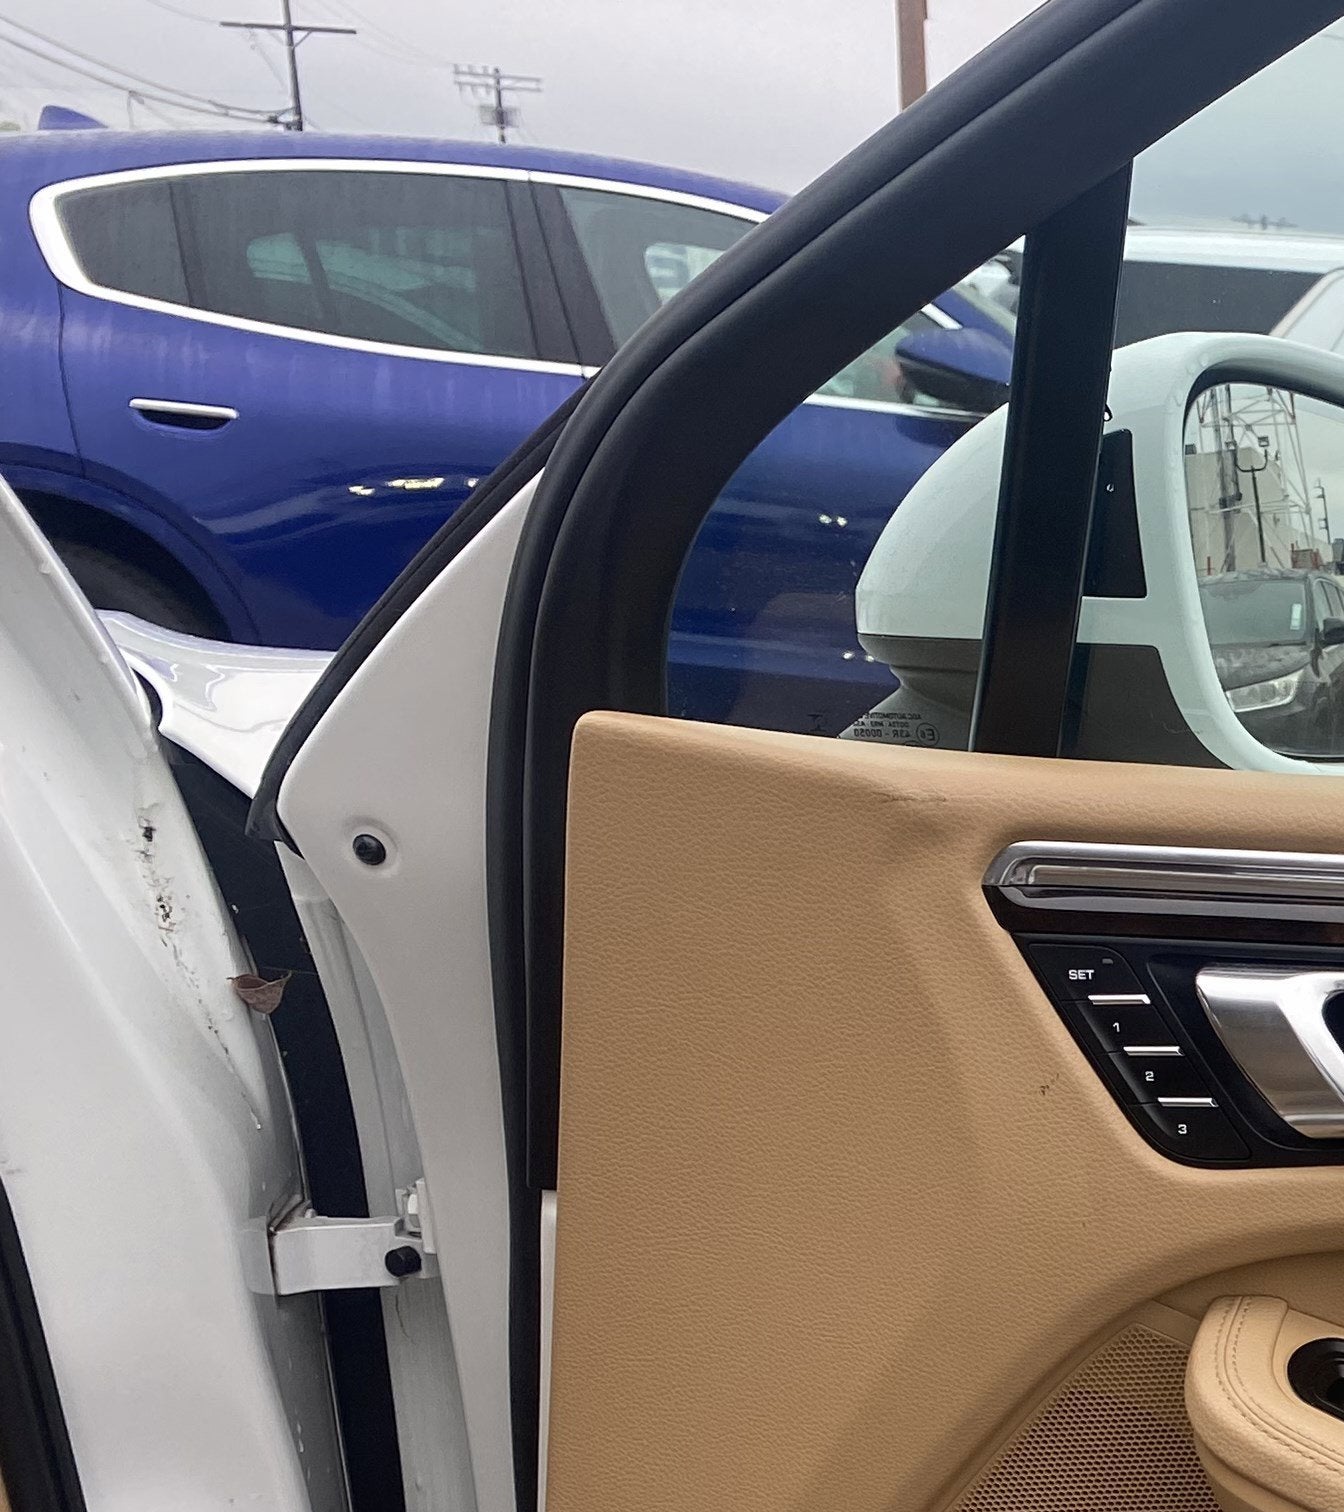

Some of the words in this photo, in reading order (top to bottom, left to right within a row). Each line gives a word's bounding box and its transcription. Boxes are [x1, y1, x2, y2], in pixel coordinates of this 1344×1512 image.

[1068, 969, 1095, 980] SET
[1112, 1022, 1120, 1032] 1
[1145, 1071, 1155, 1081] 2
[1178, 1124, 1188, 1133] 3
